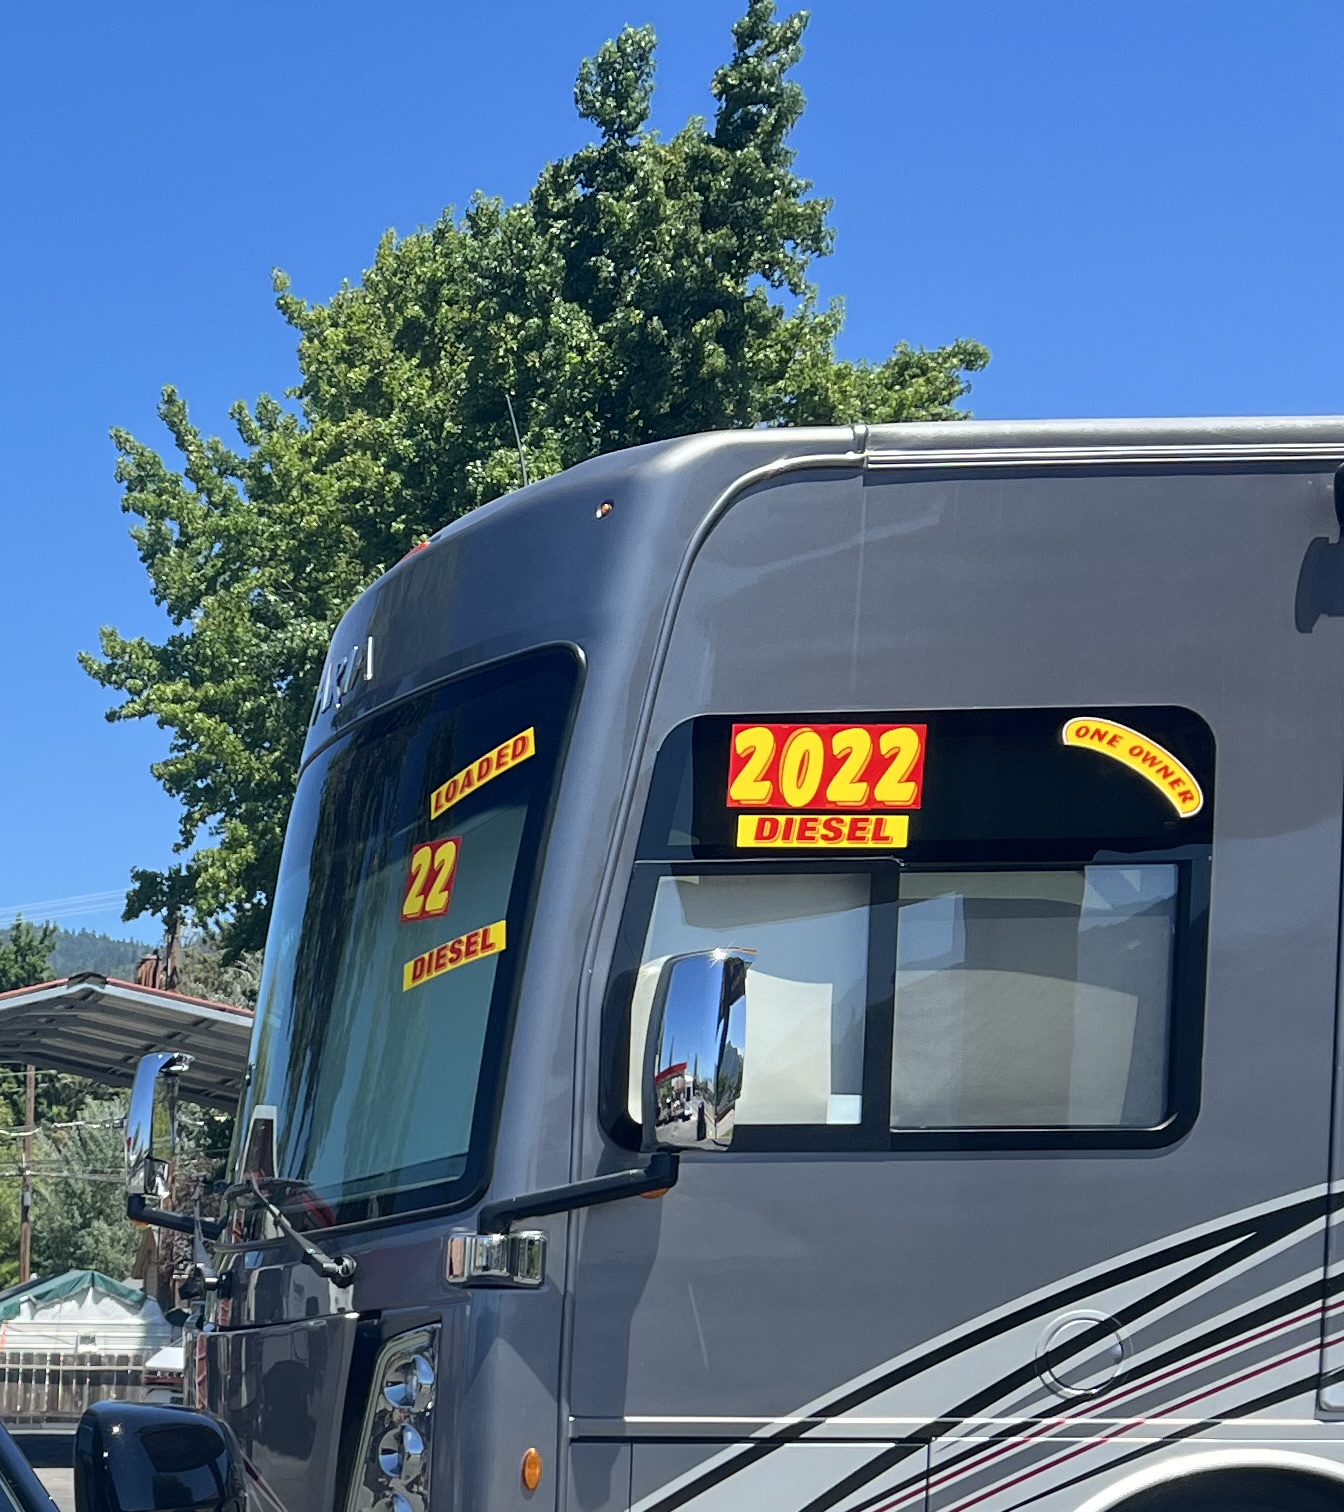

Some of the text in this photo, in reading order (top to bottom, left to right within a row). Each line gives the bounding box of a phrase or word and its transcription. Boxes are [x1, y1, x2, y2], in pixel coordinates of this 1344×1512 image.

[434, 735, 529, 813] LOADED
[730, 726, 922, 807] 2022
[1075, 725, 1195, 804] ONE OWNER
[754, 817, 892, 844] DIESEL
[403, 841, 457, 918] 22
[412, 928, 496, 983] DIESEL
